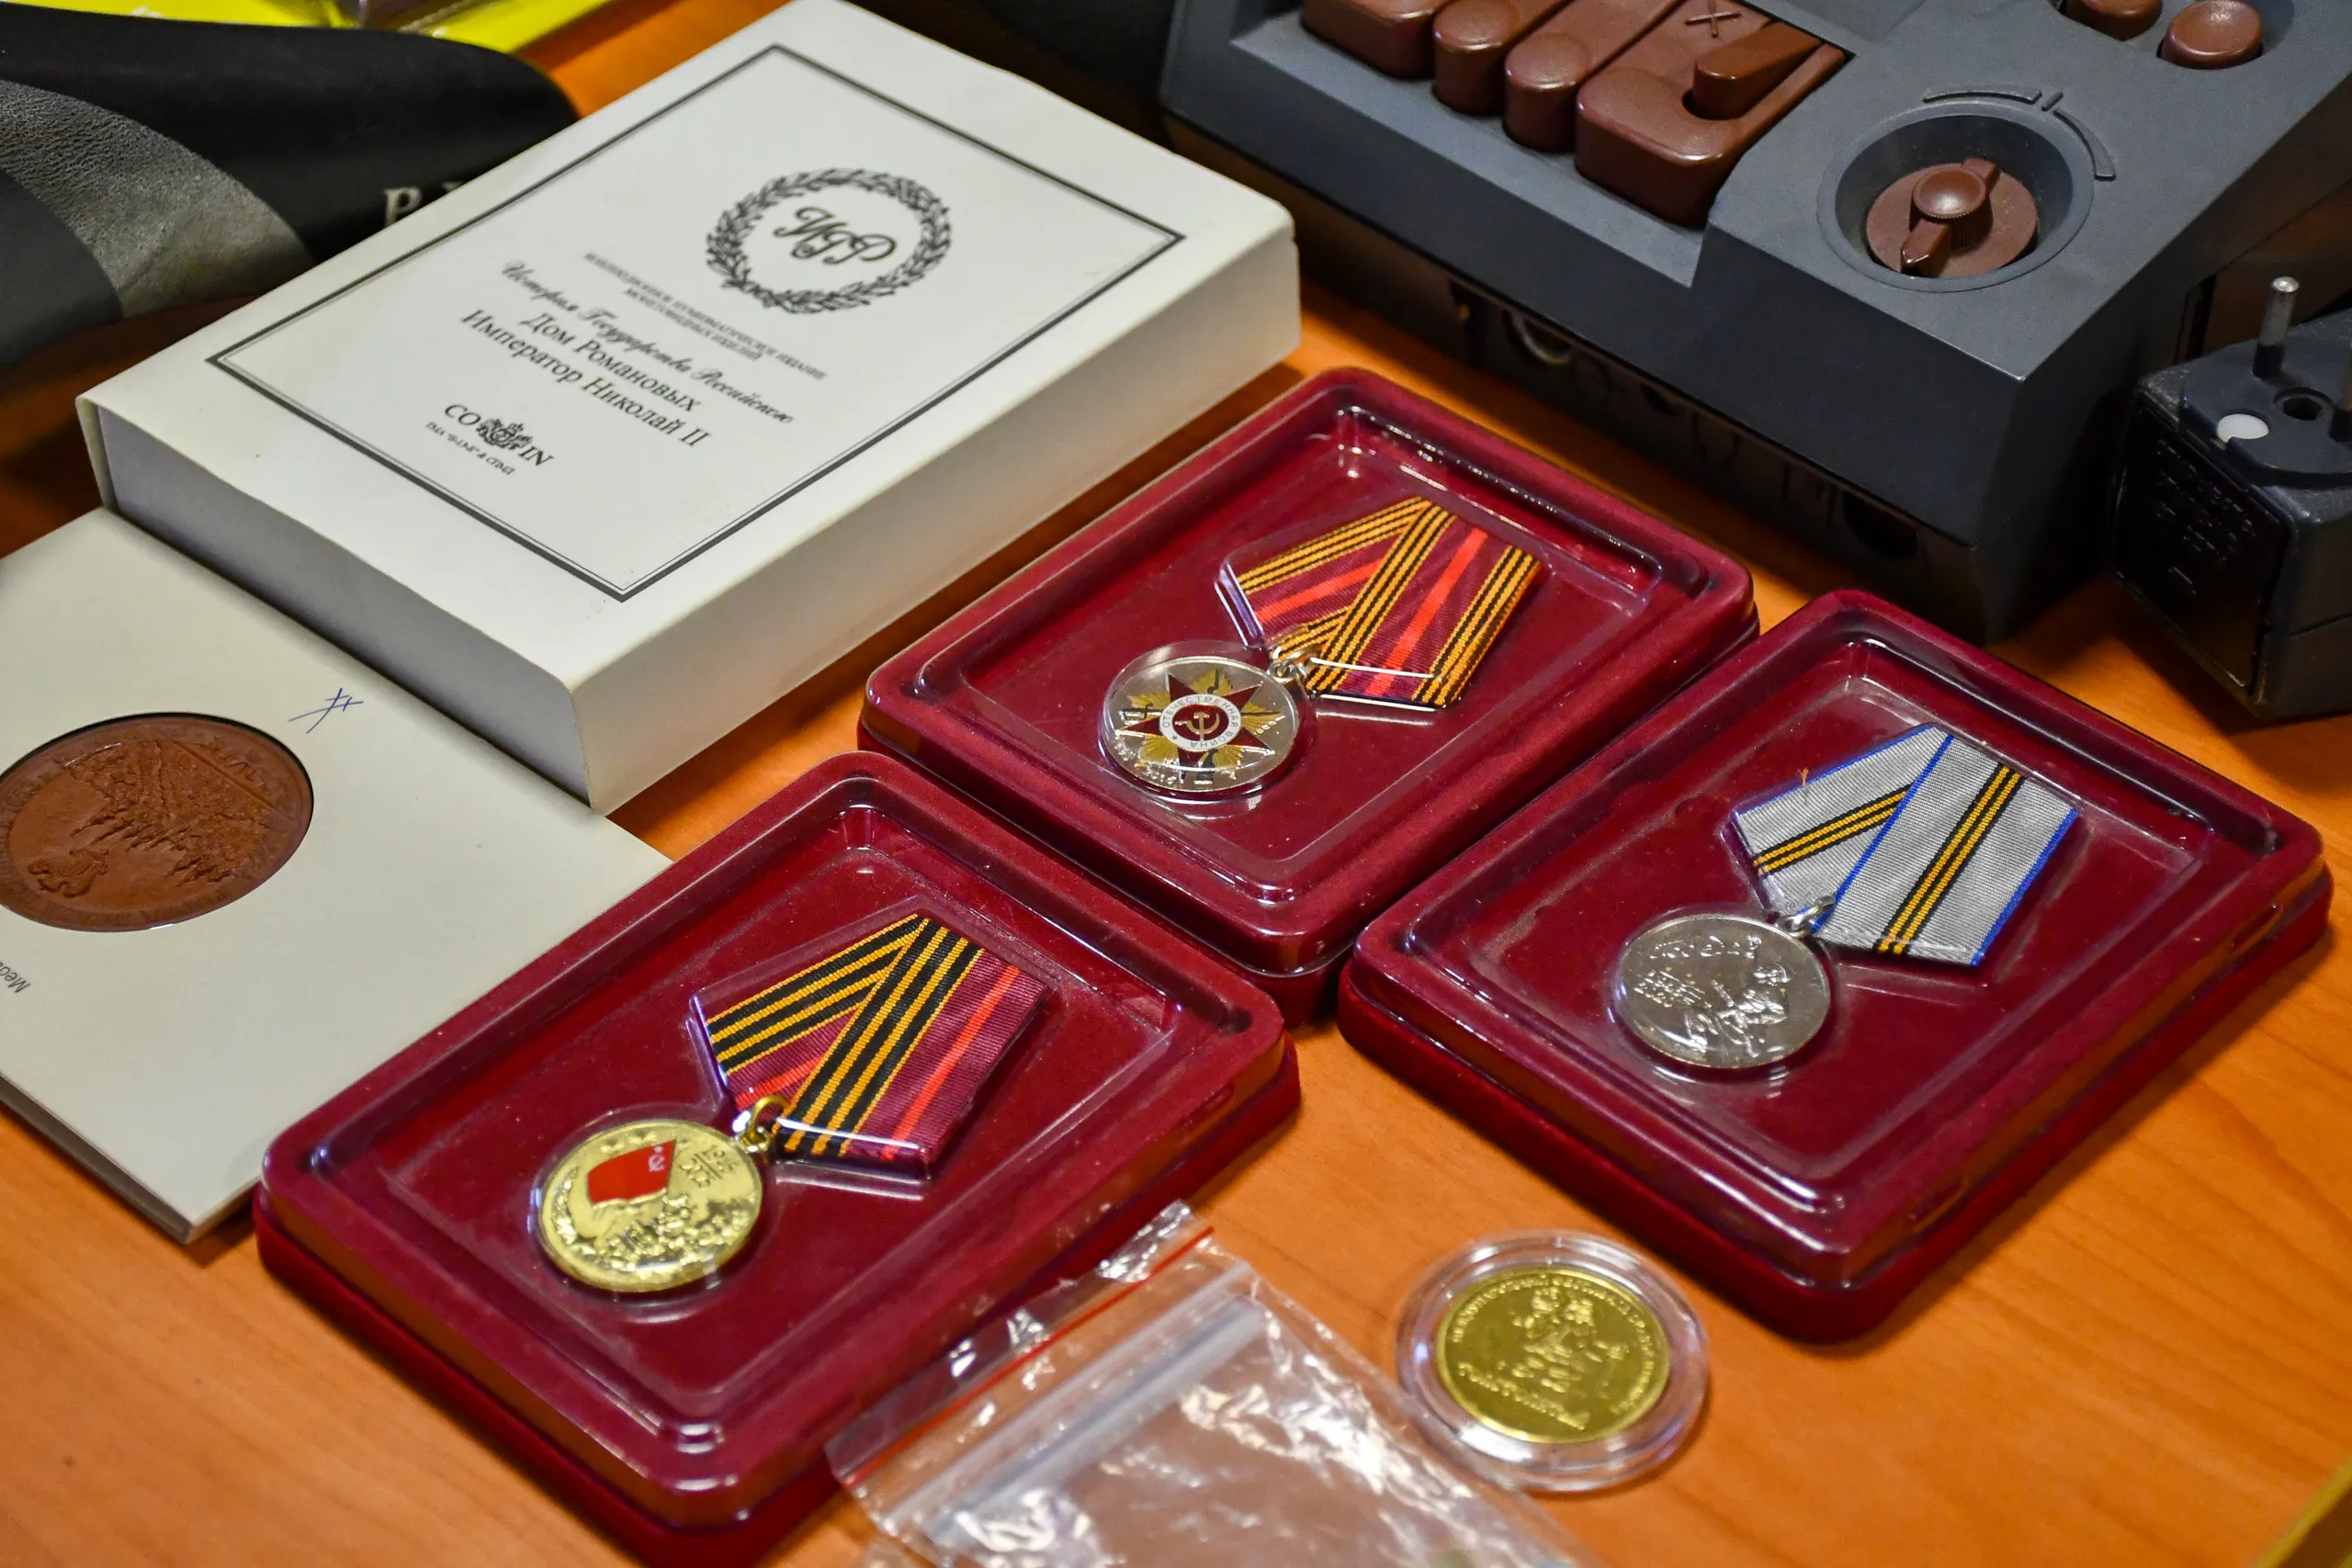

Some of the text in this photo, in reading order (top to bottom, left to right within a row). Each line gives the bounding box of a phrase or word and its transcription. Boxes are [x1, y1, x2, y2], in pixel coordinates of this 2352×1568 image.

[503, 261, 579, 311] История
[461, 310, 712, 446] Император Николай II
[519, 313, 701, 412] Дом Романовых
[1162, 695, 1238, 728] ОТЕЧЕСТВЕННАЯ
